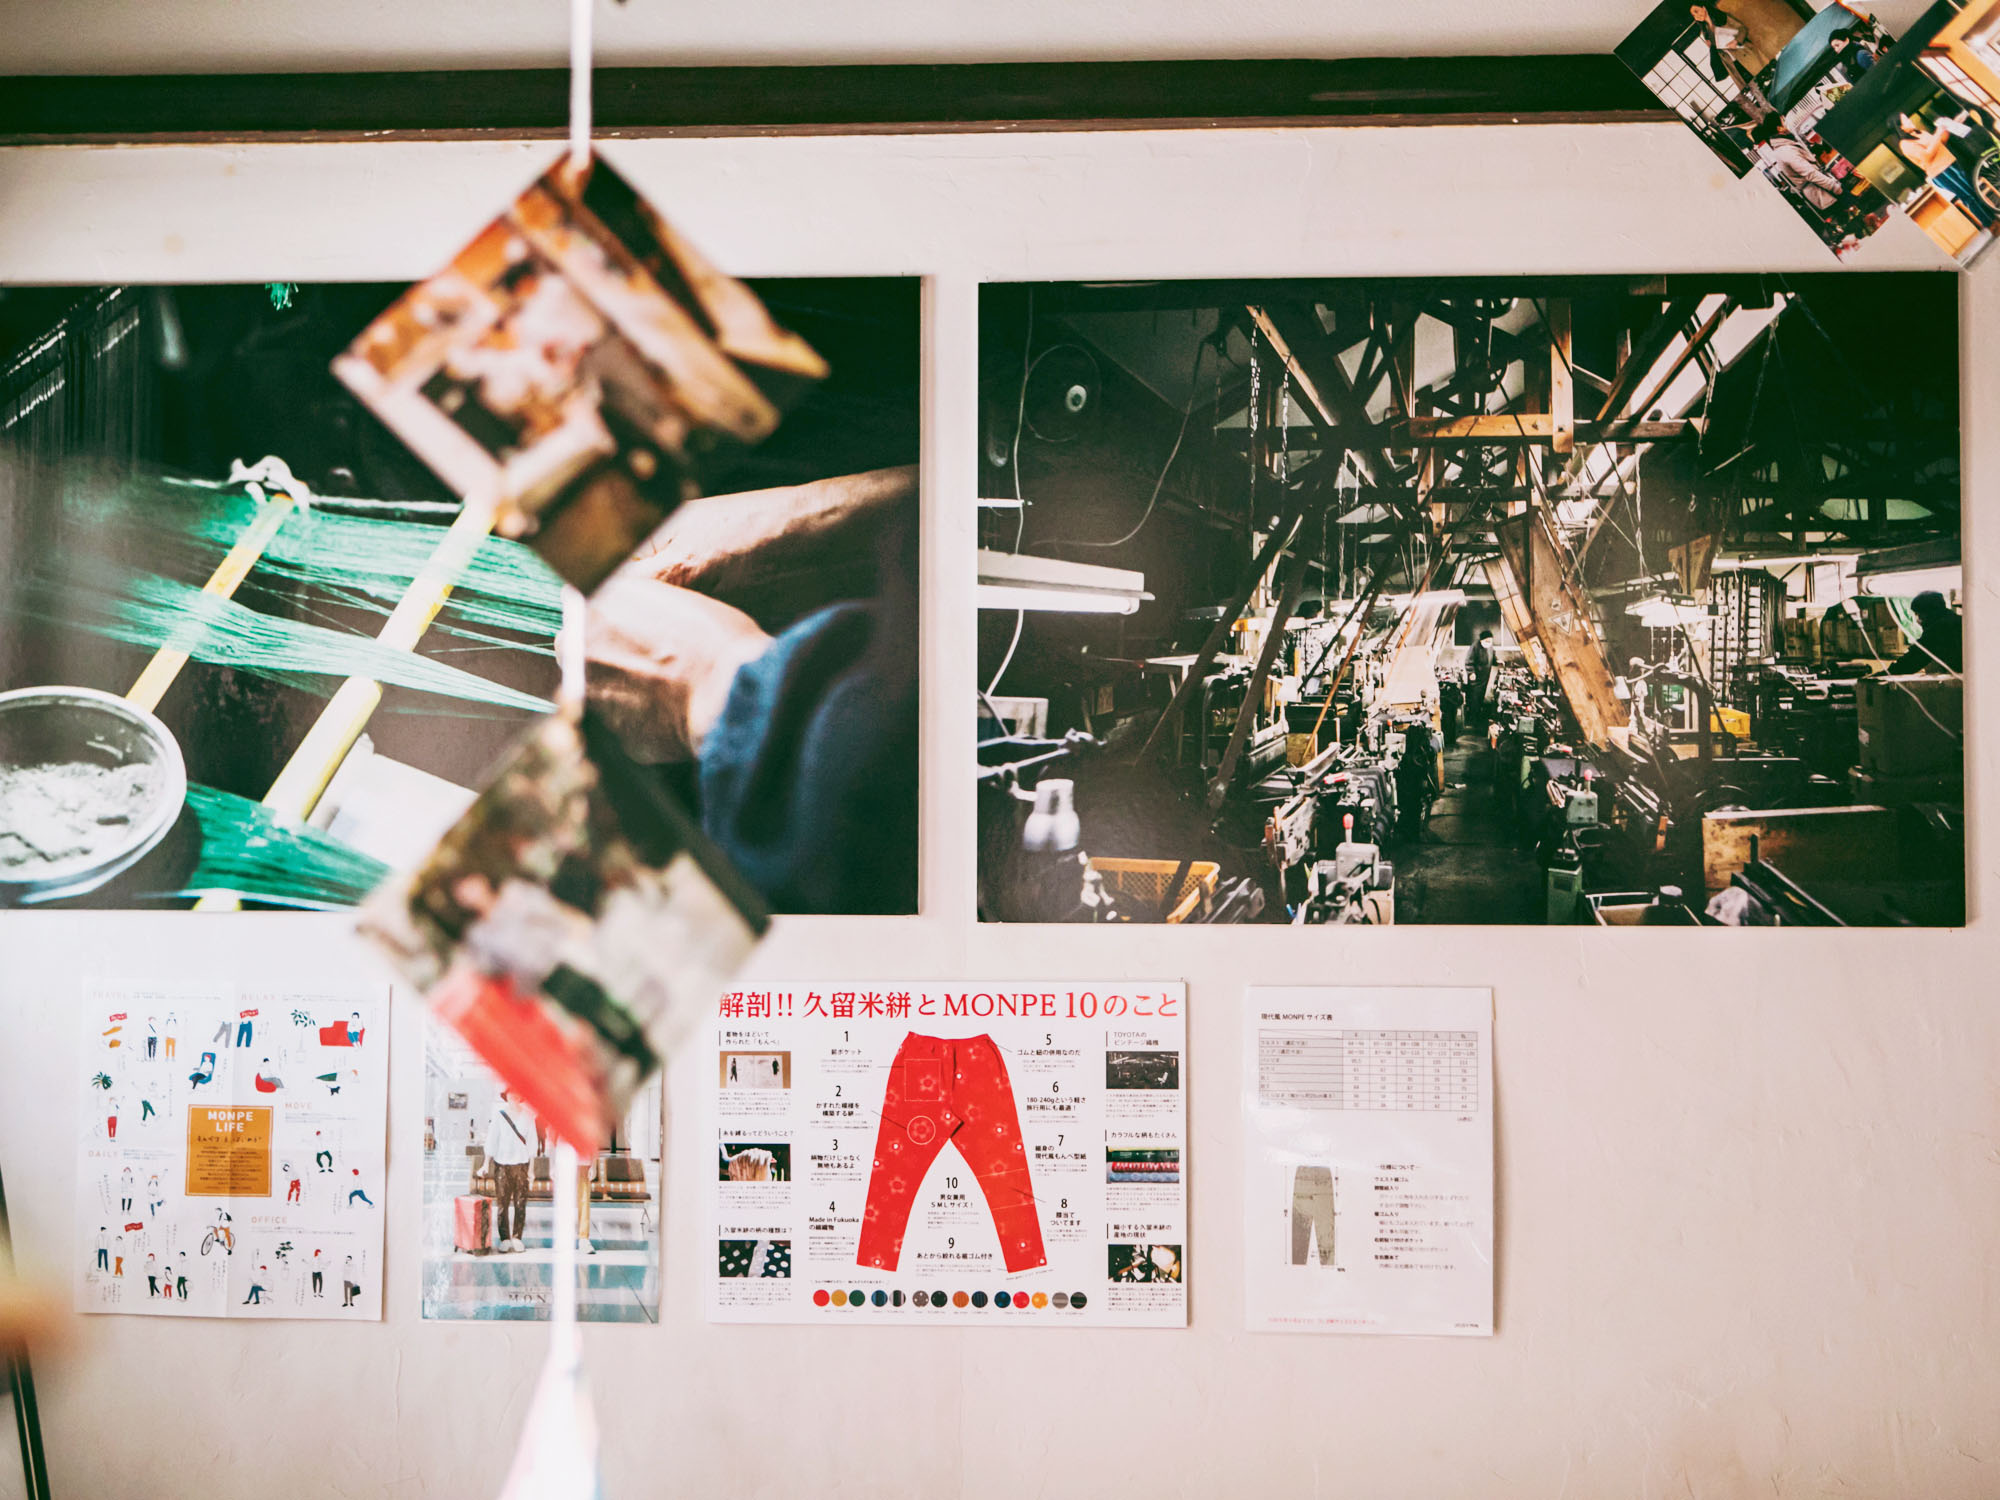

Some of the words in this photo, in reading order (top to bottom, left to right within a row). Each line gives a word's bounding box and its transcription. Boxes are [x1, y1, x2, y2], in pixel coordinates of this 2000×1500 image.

[844, 1030, 849, 1043] 1
[1046, 1034, 1052, 1046] 5
[835, 1086, 842, 1097] 2
[1052, 1081, 1059, 1093] 6
[207, 1110, 254, 1121] MONPE
[215, 1122, 245, 1133] LIFE
[832, 1139, 838, 1151] 3
[1058, 1134, 1064, 1146] 7
[946, 1176, 958, 1189] 10
[829, 1201, 836, 1213] 4
[1061, 1199, 1068, 1209] 8
[948, 1237, 955, 1249] 9
